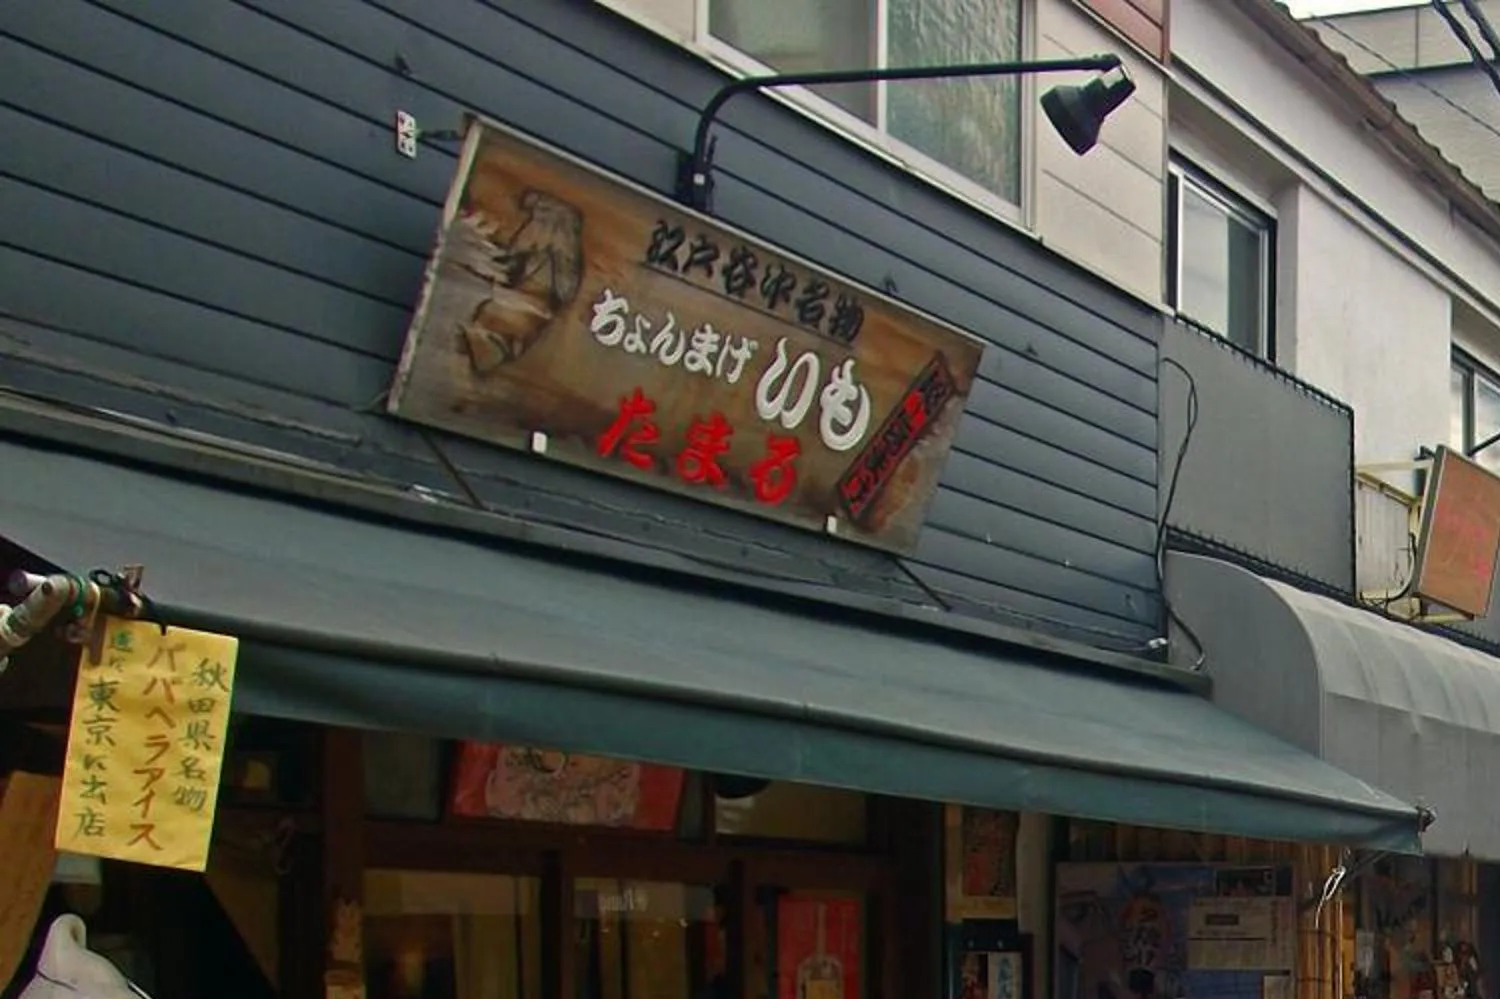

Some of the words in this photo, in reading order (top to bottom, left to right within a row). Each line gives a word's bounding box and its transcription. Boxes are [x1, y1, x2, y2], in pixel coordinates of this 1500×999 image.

[597, 386, 802, 505] たまる
[127, 641, 188, 851] ババヘラアイス
[172, 657, 229, 814] 秋田県名物
